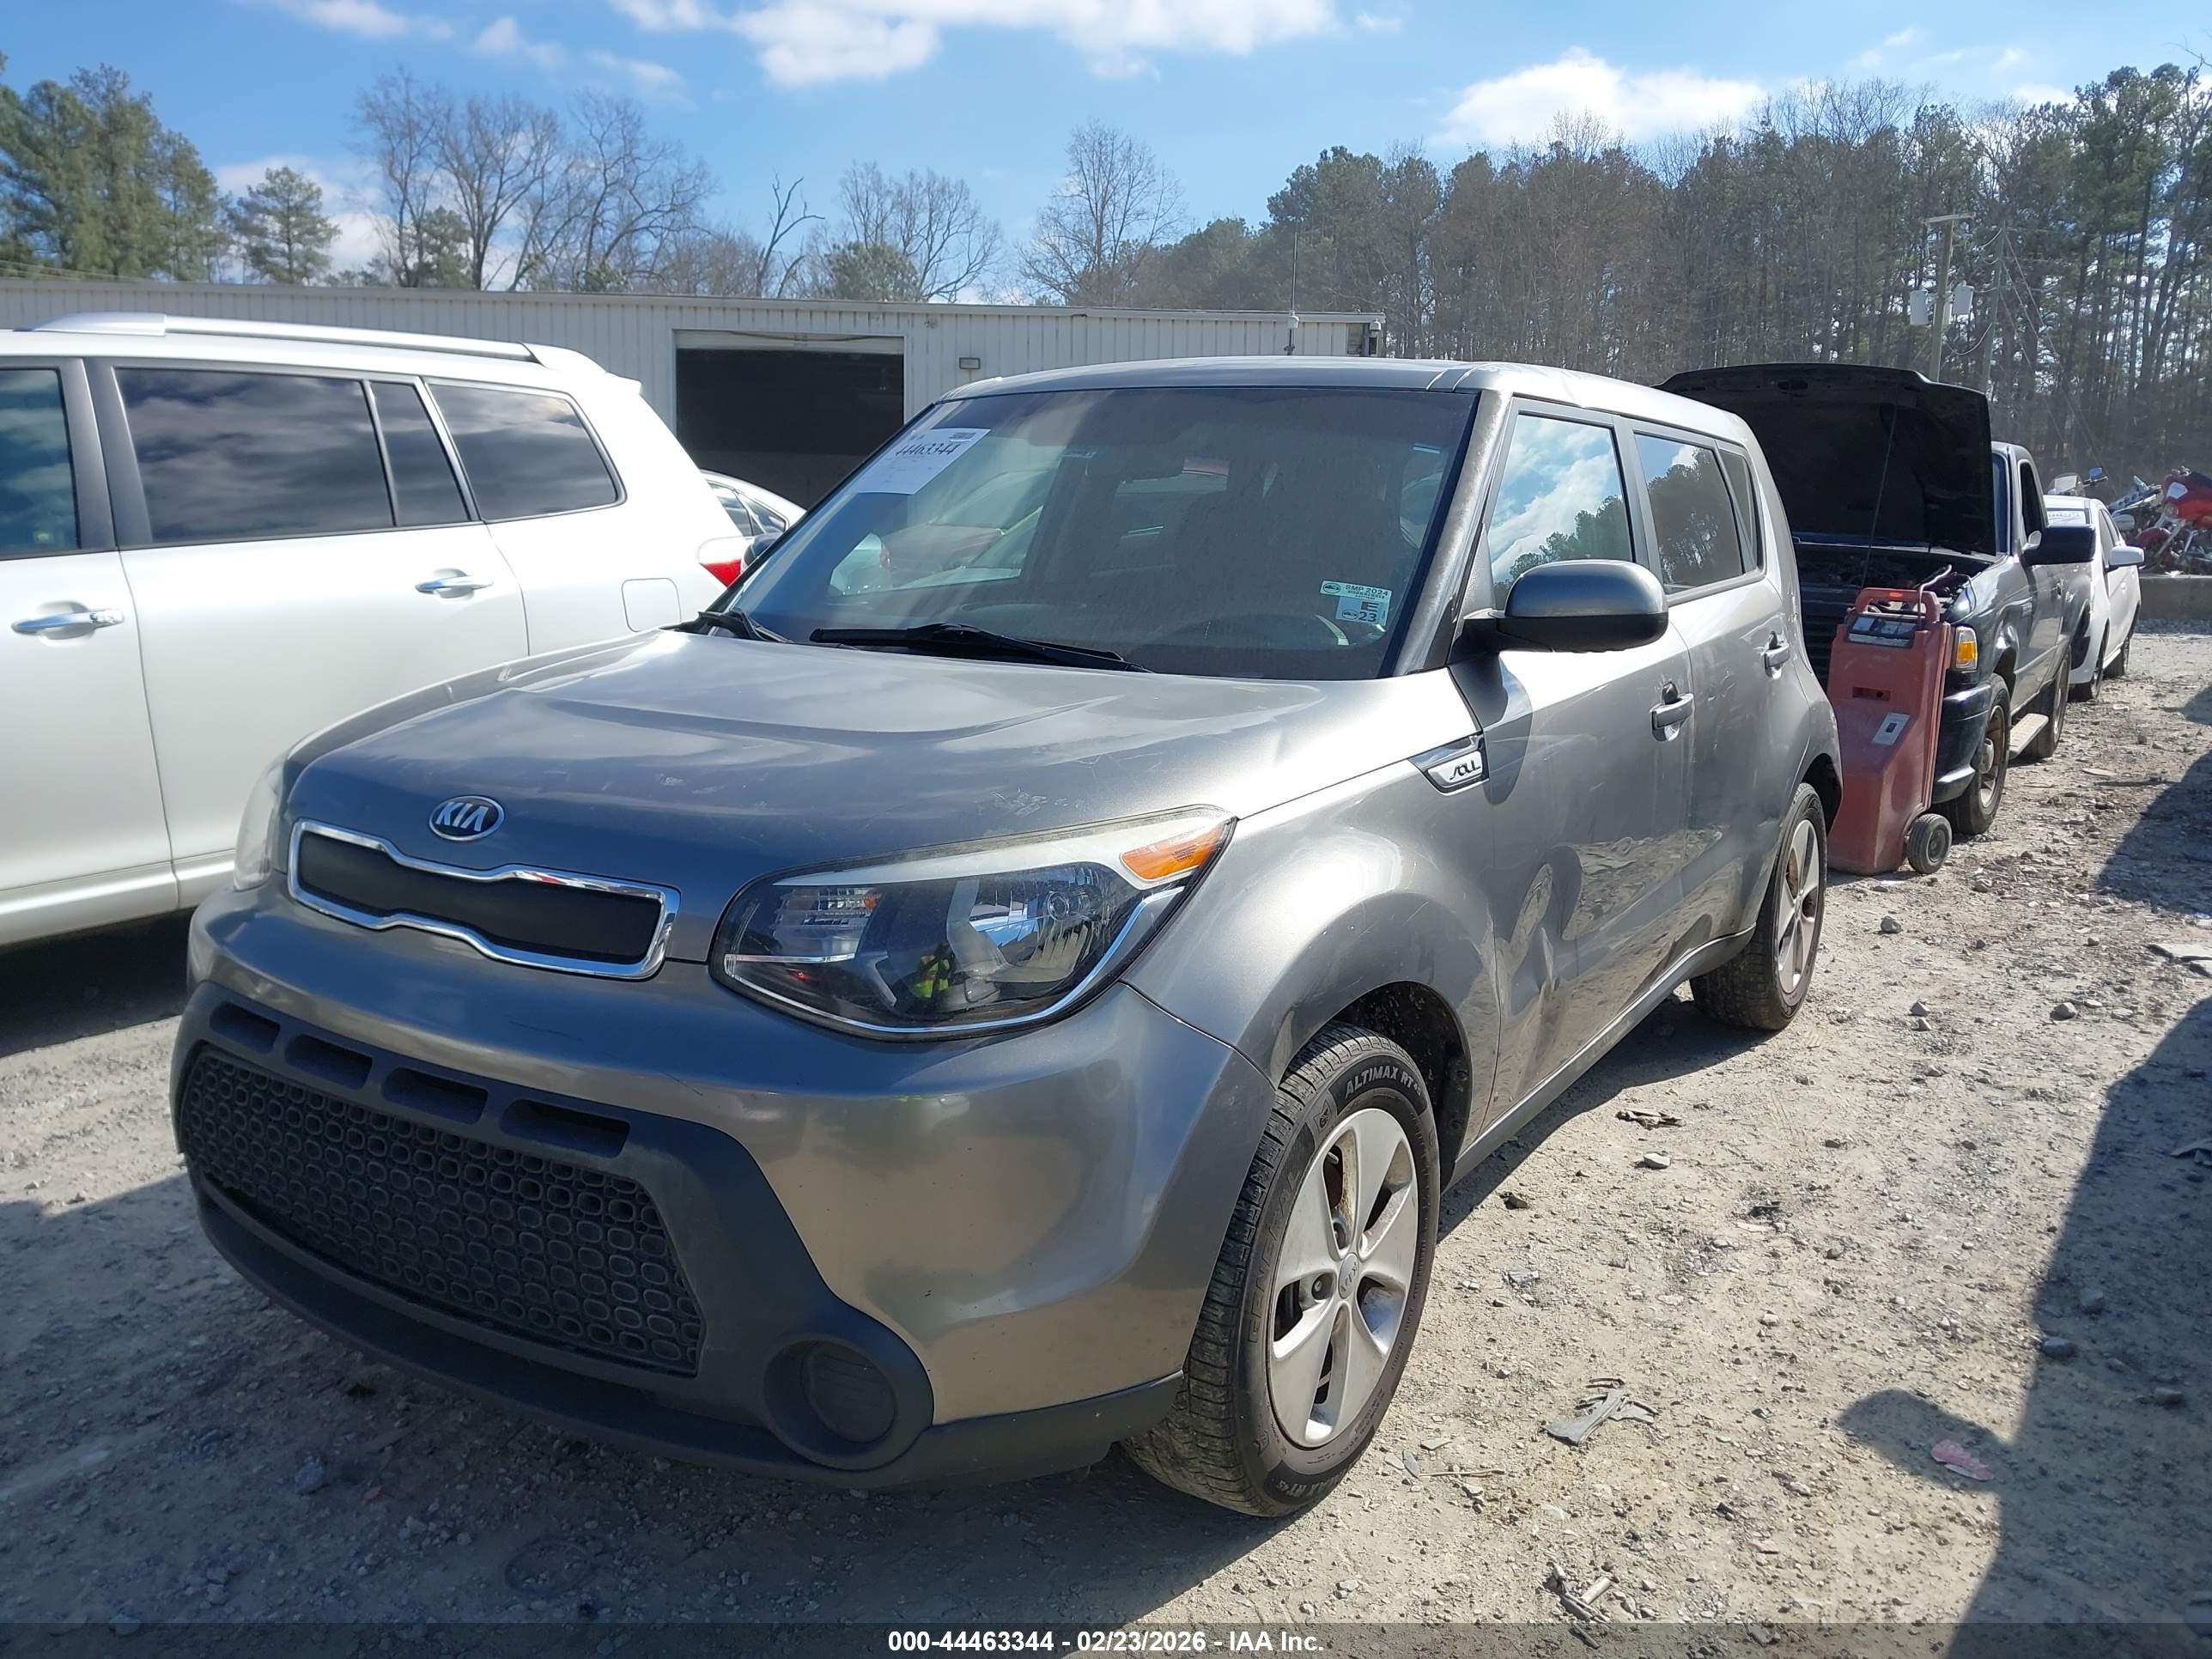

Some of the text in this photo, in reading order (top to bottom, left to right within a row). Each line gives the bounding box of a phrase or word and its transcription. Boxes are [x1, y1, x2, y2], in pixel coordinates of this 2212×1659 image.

[1365, 588, 1389, 597] 2024
[1358, 611, 1377, 623] 23
[434, 801, 489, 832] KIA
[1345, 1065, 1400, 1099] ALTIMAX
